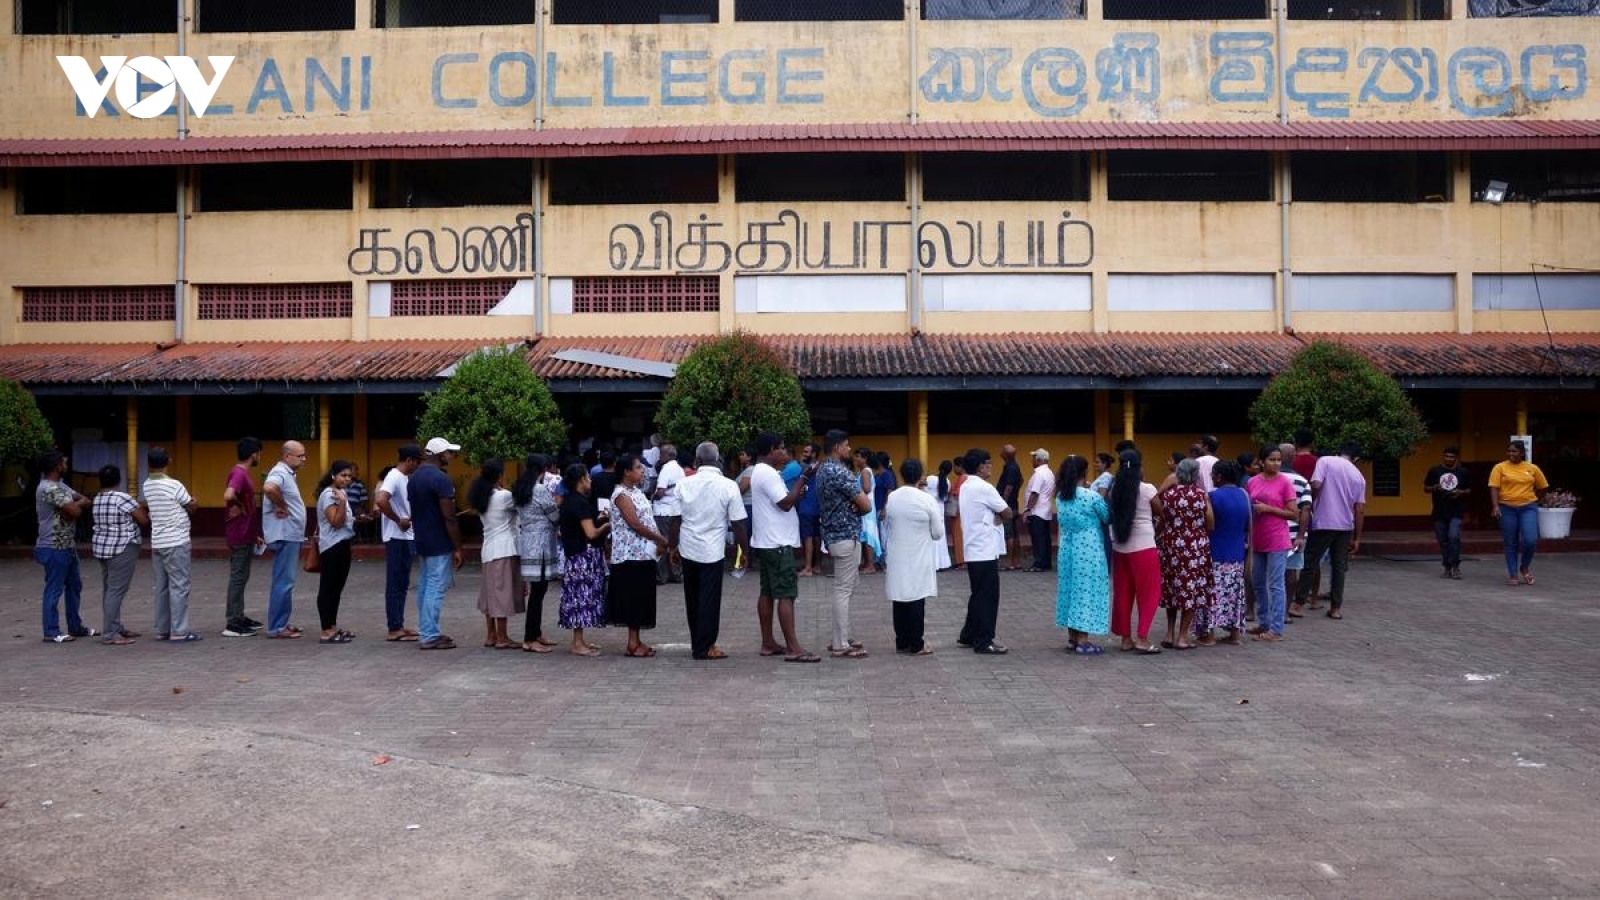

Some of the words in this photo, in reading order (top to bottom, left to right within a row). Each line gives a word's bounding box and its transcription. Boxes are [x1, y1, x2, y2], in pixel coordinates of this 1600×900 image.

[433, 47, 825, 108] COLLEGE
[347, 212, 536, 275] கலணி
[609, 208, 1095, 273] வித்தியாலயம்
